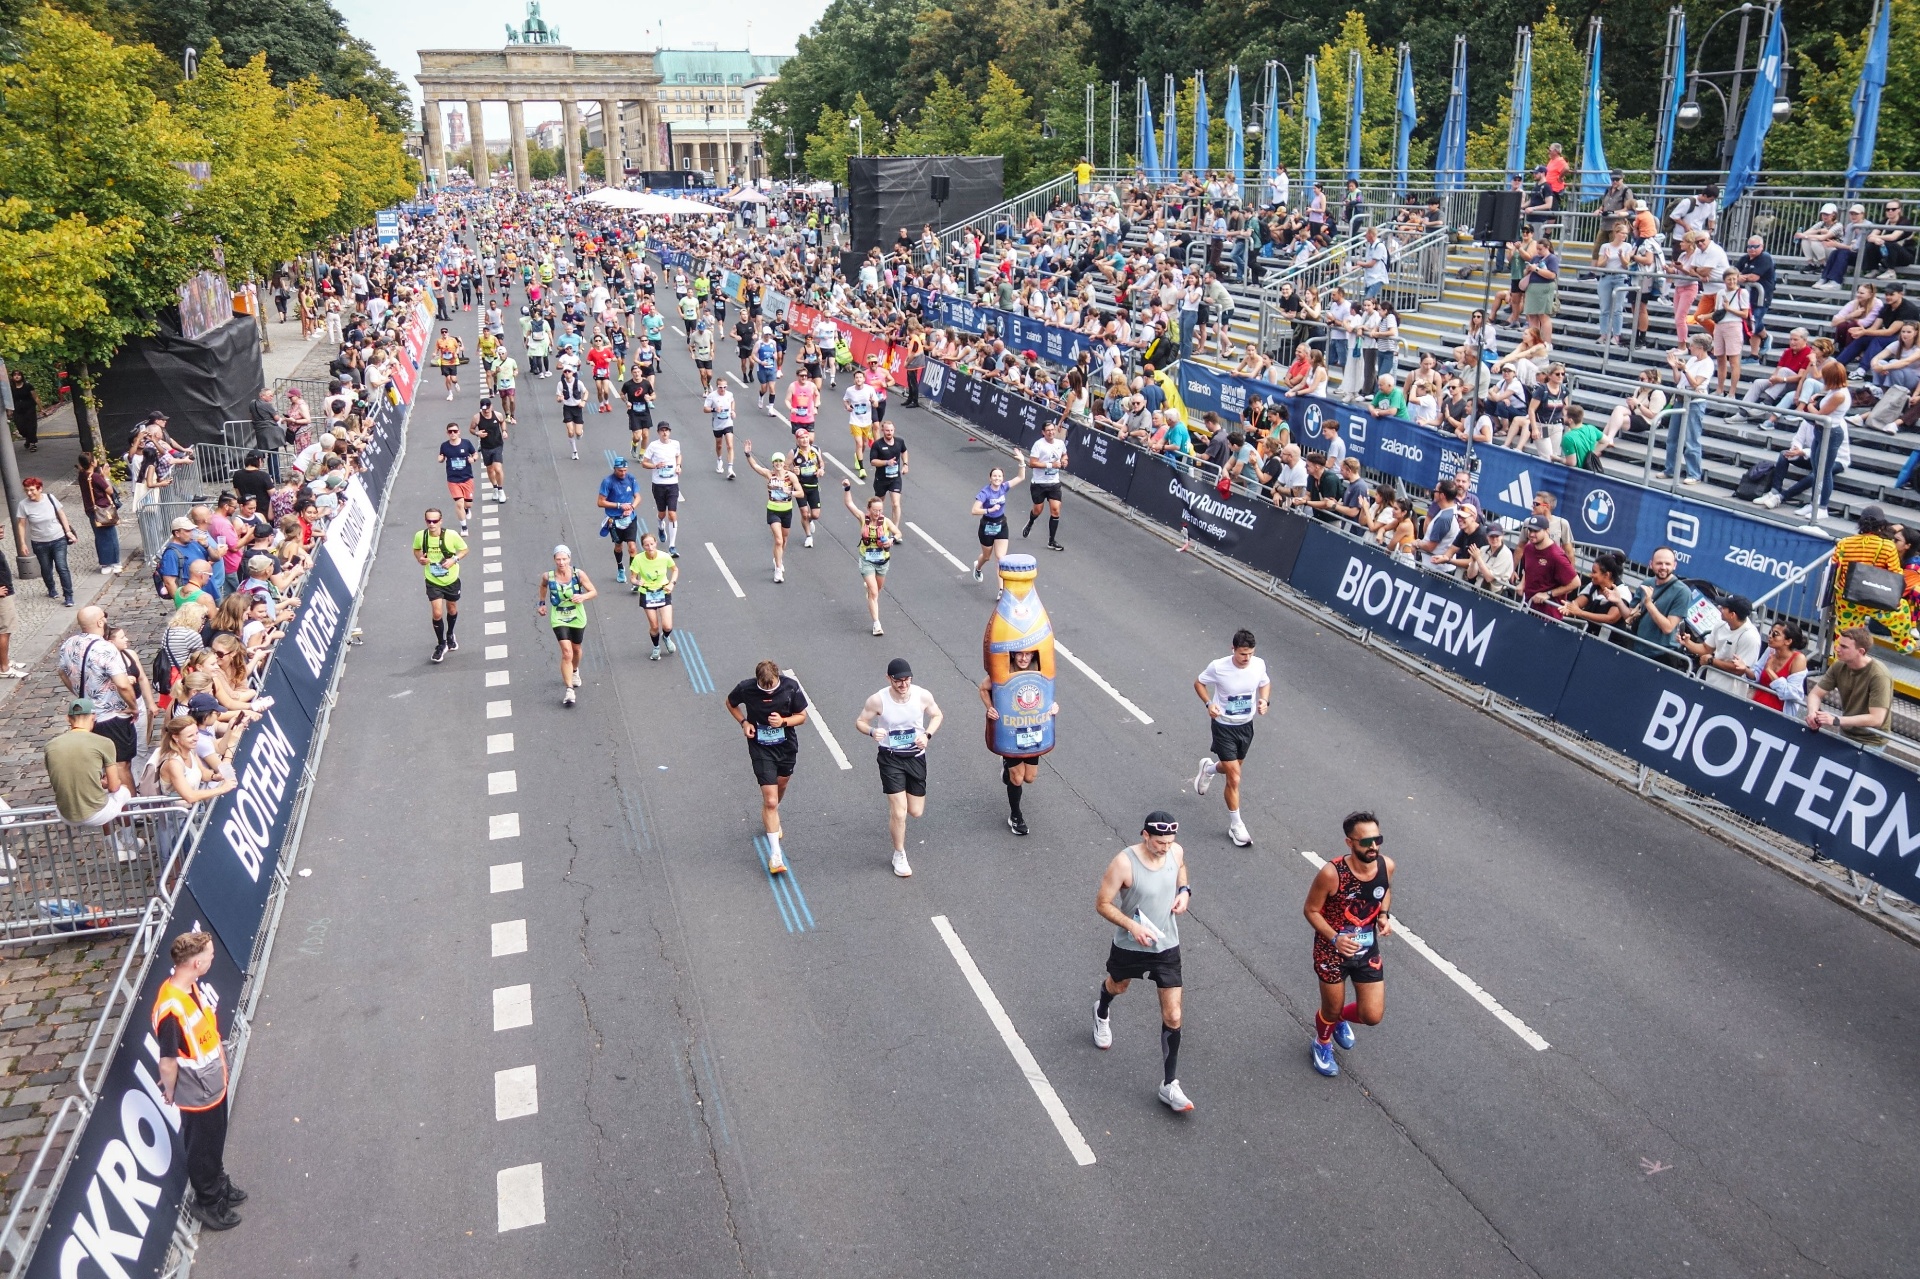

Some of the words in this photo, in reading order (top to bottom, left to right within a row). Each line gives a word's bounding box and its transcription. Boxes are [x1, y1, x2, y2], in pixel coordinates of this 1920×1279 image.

[1188, 381, 1211, 396] zalando
[1220, 394, 1237, 405] BERLIN
[1221, 384, 1237, 397] BMW
[1349, 443, 1365, 455] ABBOTT
[1381, 437, 1422, 462] zalando
[1169, 478, 1201, 510] Galaxy
[1438, 471, 1478, 494] MARON
[1181, 508, 1191, 521] We
[1190, 515, 1198, 526] run
[1198, 519, 1207, 531] on
[1206, 523, 1227, 540] sleep
[1724, 545, 1806, 584] zalando
[1336, 555, 1496, 667] BIOTHERM
[295, 577, 340, 679] BIOTHERM
[222, 710, 296, 883] BIOTHERM
[1642, 689, 1920, 879] BIOTHERM
